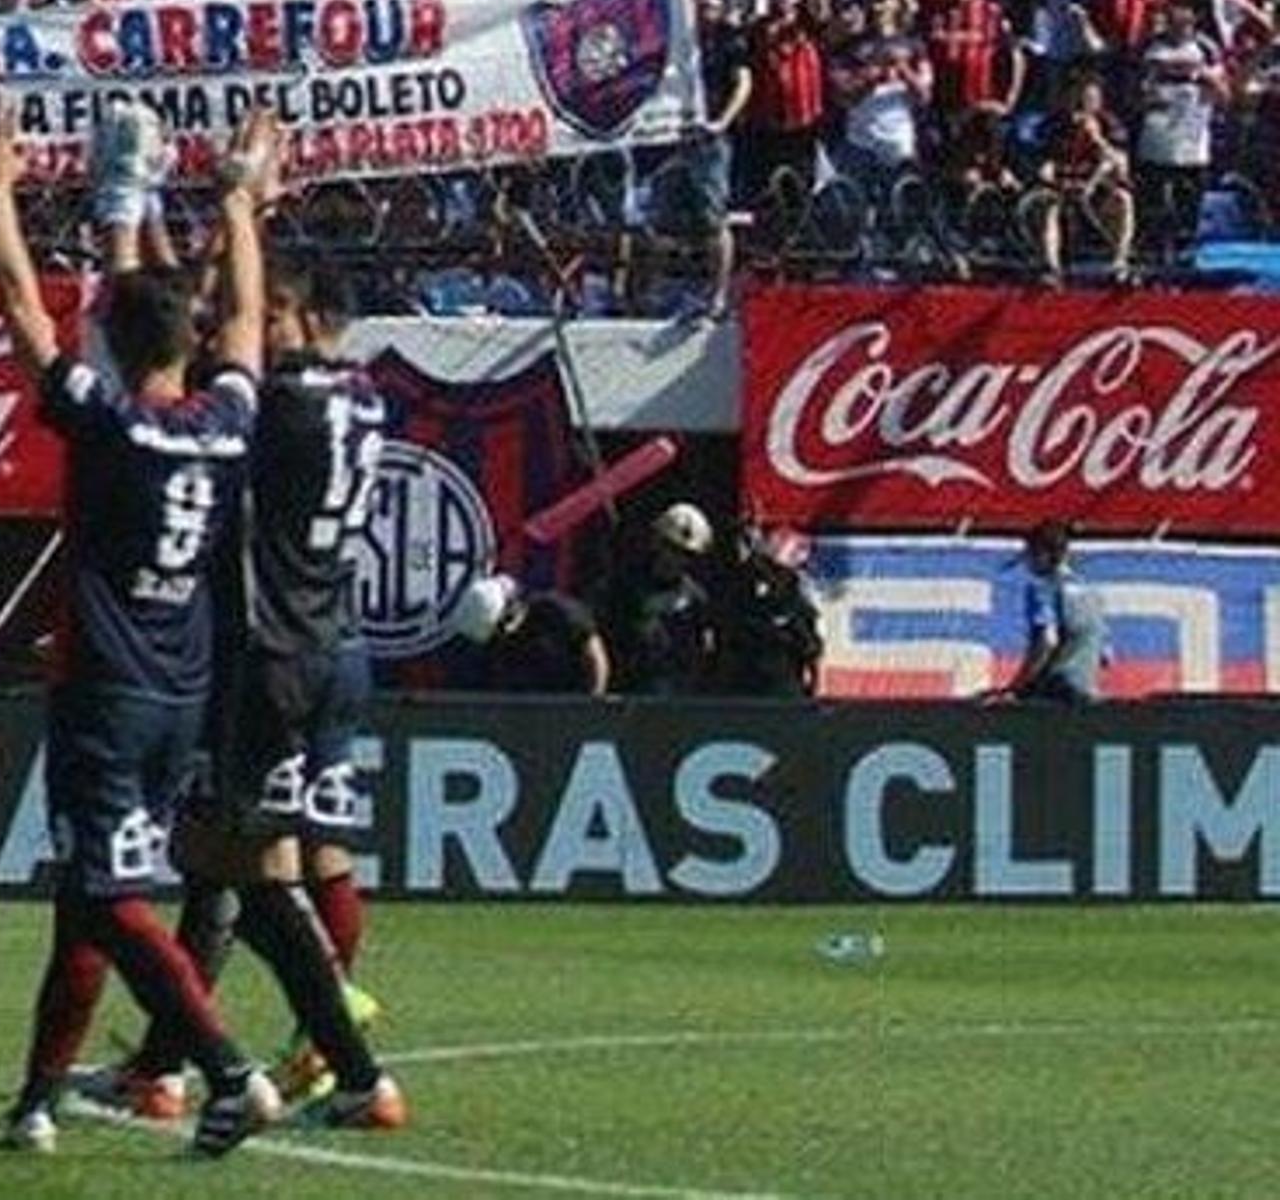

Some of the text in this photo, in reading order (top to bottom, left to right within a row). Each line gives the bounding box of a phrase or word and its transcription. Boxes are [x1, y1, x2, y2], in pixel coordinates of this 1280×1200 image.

[312, 69, 467, 122] BOLETO
[767, 322, 1280, 492] Coca-Cola
[156, 464, 213, 569] 9
[844, 740, 1280, 897] CLIM
